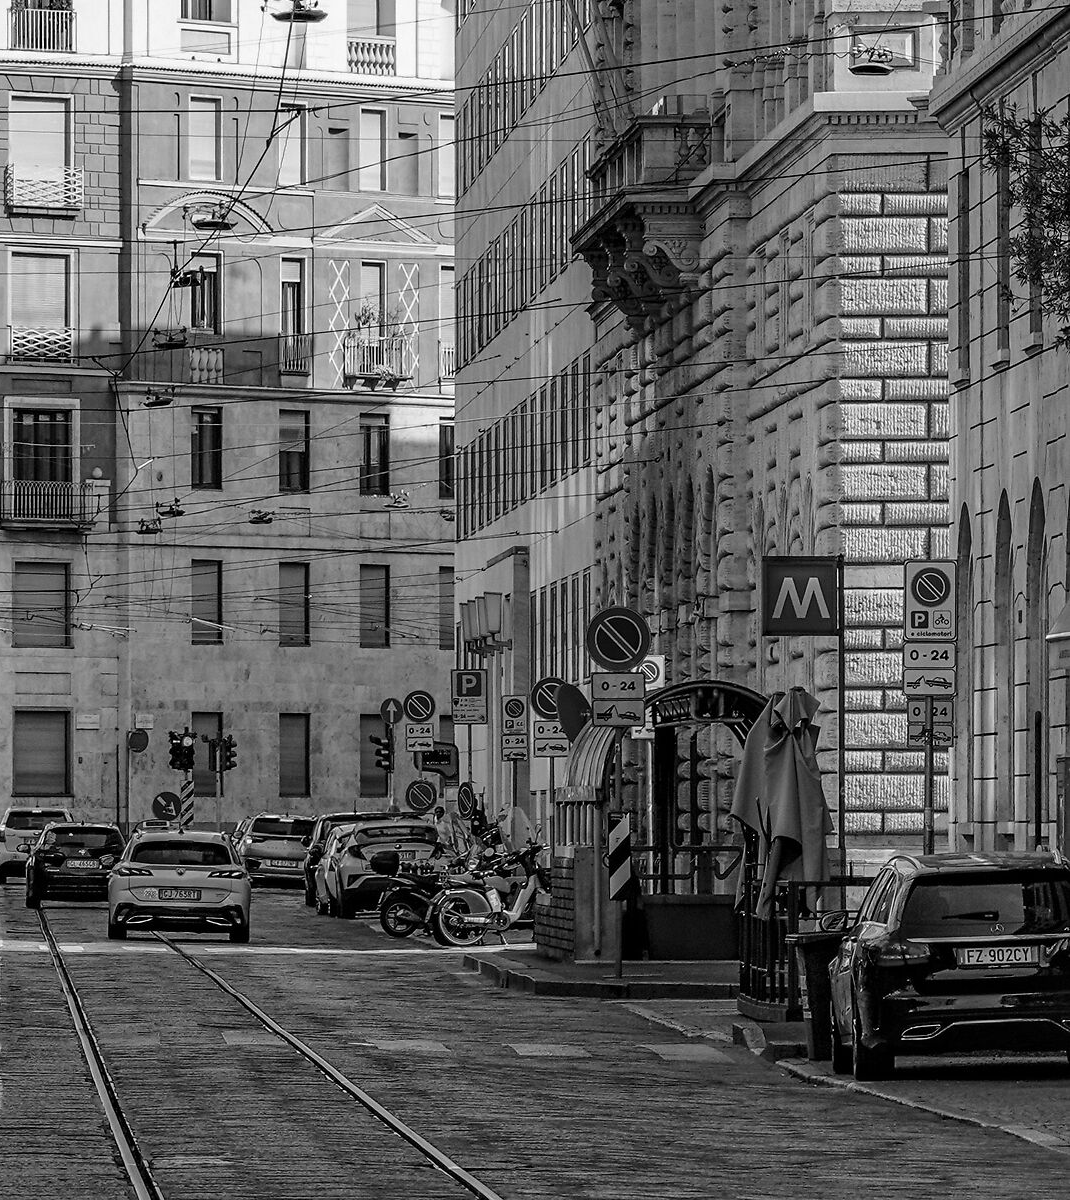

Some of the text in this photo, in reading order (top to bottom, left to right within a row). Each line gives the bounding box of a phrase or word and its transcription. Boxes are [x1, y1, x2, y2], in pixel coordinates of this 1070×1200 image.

[772, 577, 830, 618] M
[914, 613, 926, 627] P
[461, 675, 477, 695] P
